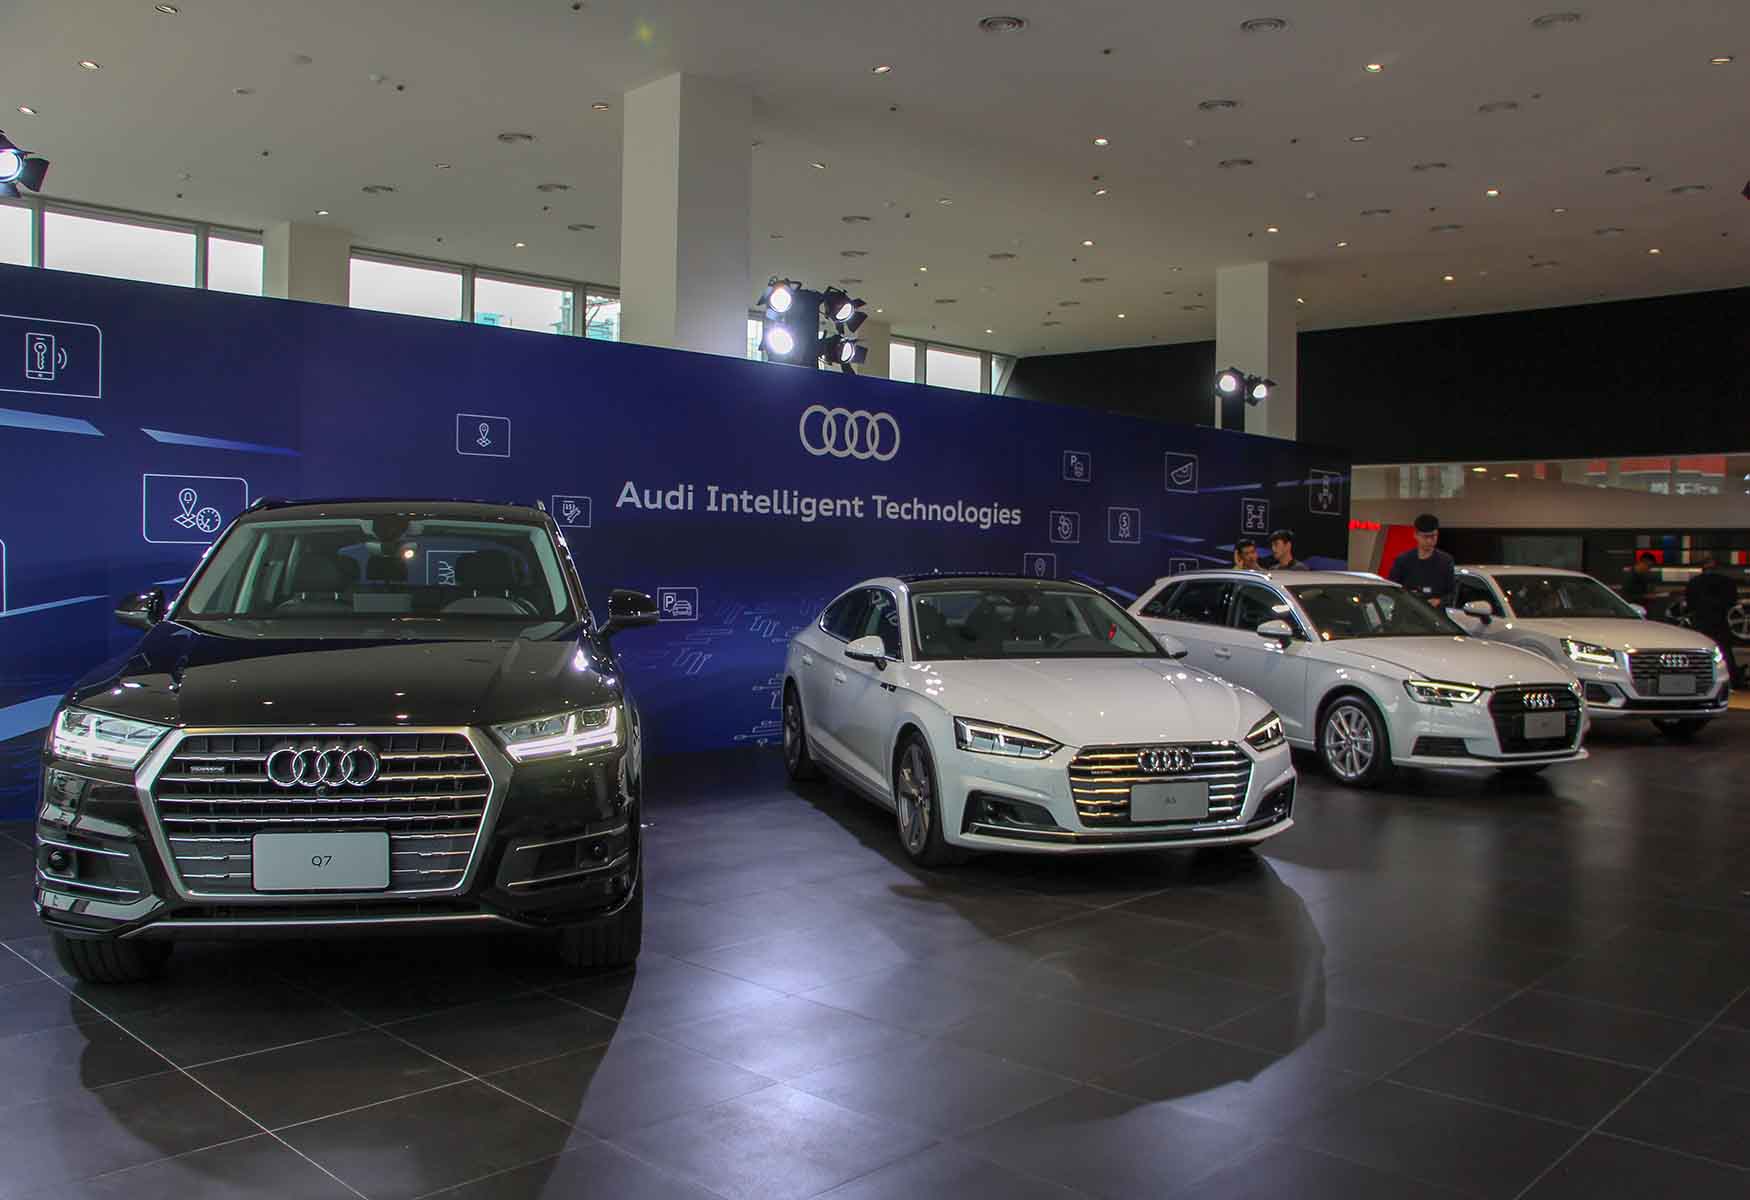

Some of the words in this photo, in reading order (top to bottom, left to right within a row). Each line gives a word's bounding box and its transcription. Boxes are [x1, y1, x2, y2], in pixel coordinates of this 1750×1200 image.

[615, 480, 694, 511] Audi
[706, 485, 864, 523] Intelligent
[871, 495, 1022, 530] Technologies
[665, 595, 674, 609] P
[311, 855, 333, 867] Q7
